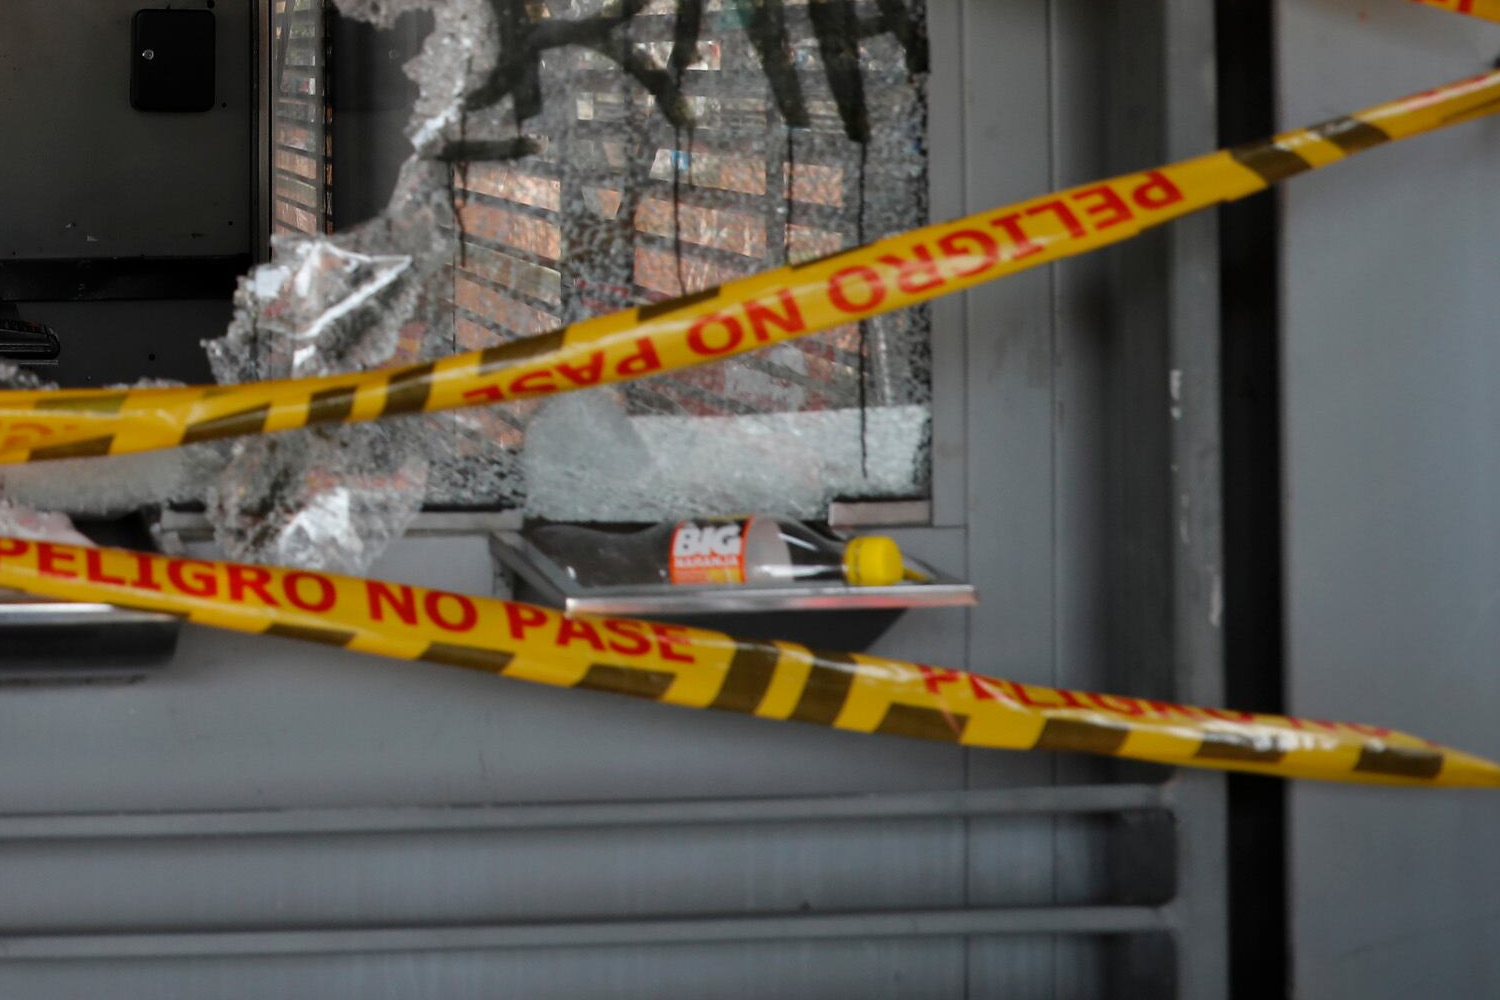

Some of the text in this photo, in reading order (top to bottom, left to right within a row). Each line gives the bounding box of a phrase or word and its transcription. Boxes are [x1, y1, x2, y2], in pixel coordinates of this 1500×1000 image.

[828, 170, 1184, 313] PELIGRO
[687, 288, 805, 356] NO
[674, 521, 741, 555] BIG
[674, 555, 739, 568] NARANJA
[365, 579, 478, 632] NO
[504, 601, 695, 664] PASE
